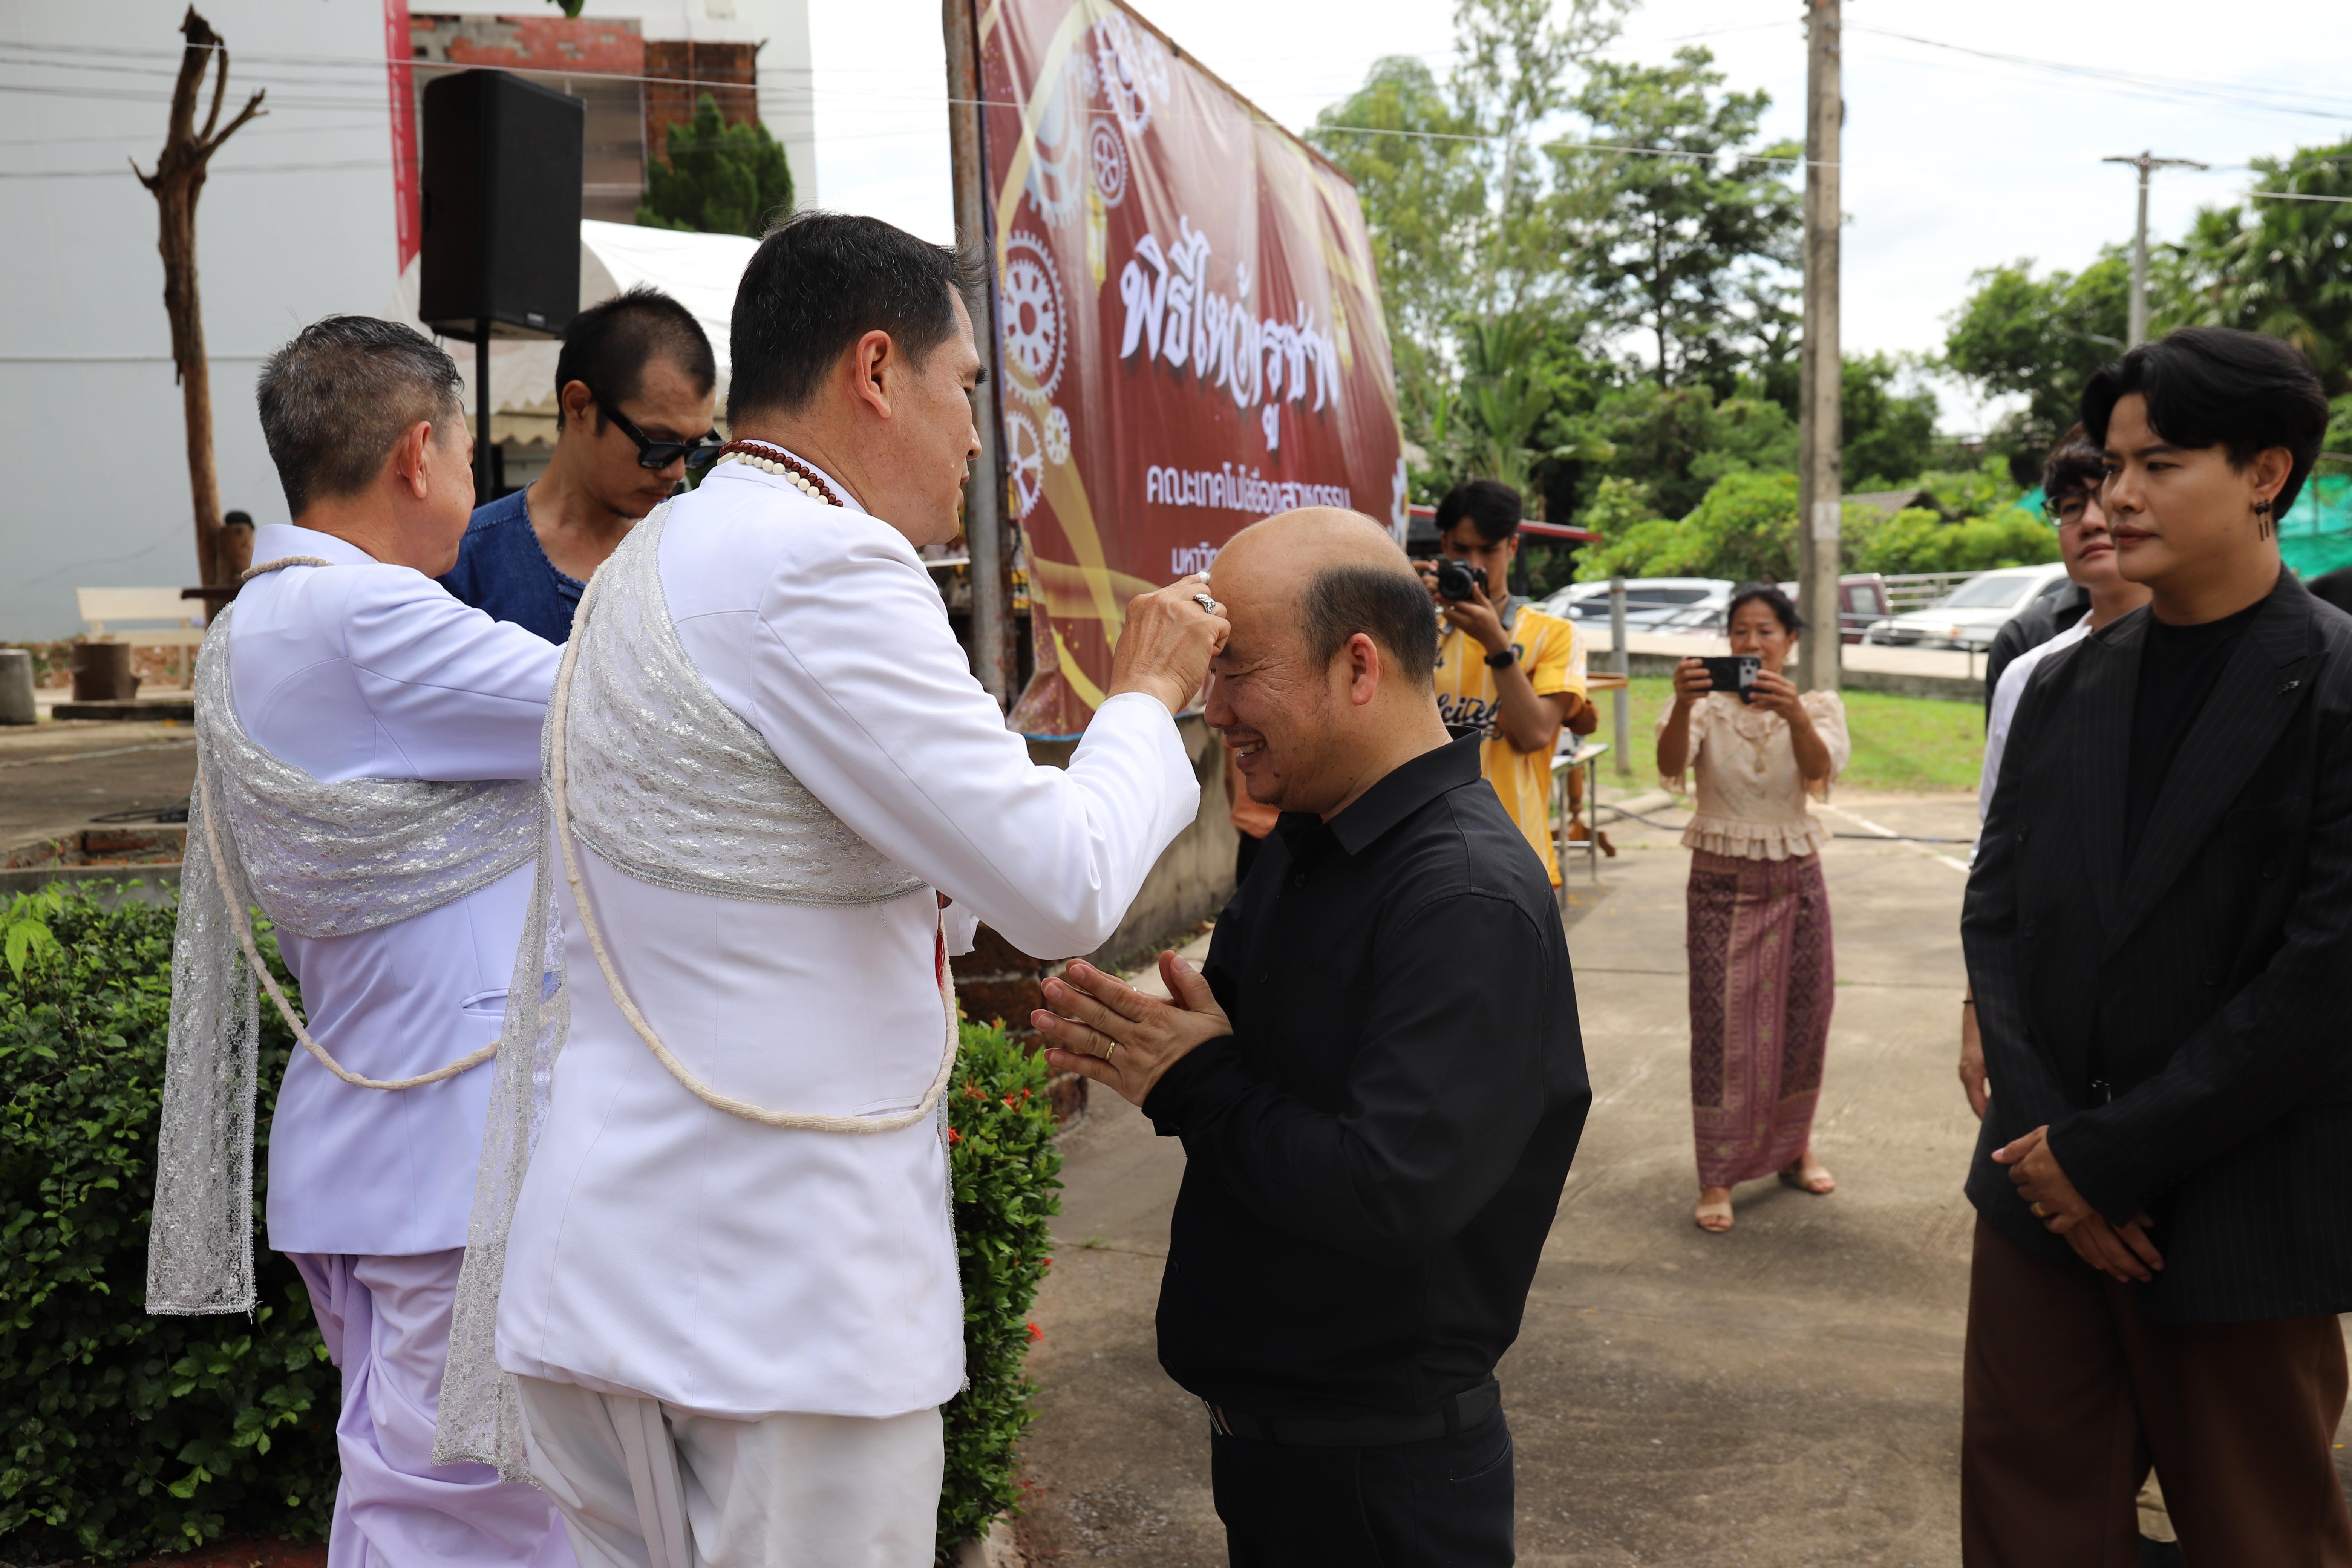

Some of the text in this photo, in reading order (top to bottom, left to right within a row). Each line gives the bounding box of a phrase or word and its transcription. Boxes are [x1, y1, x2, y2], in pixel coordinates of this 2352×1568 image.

[1147, 461, 1351, 514] คณะเทคโนโลยีอตสาหกรรม
